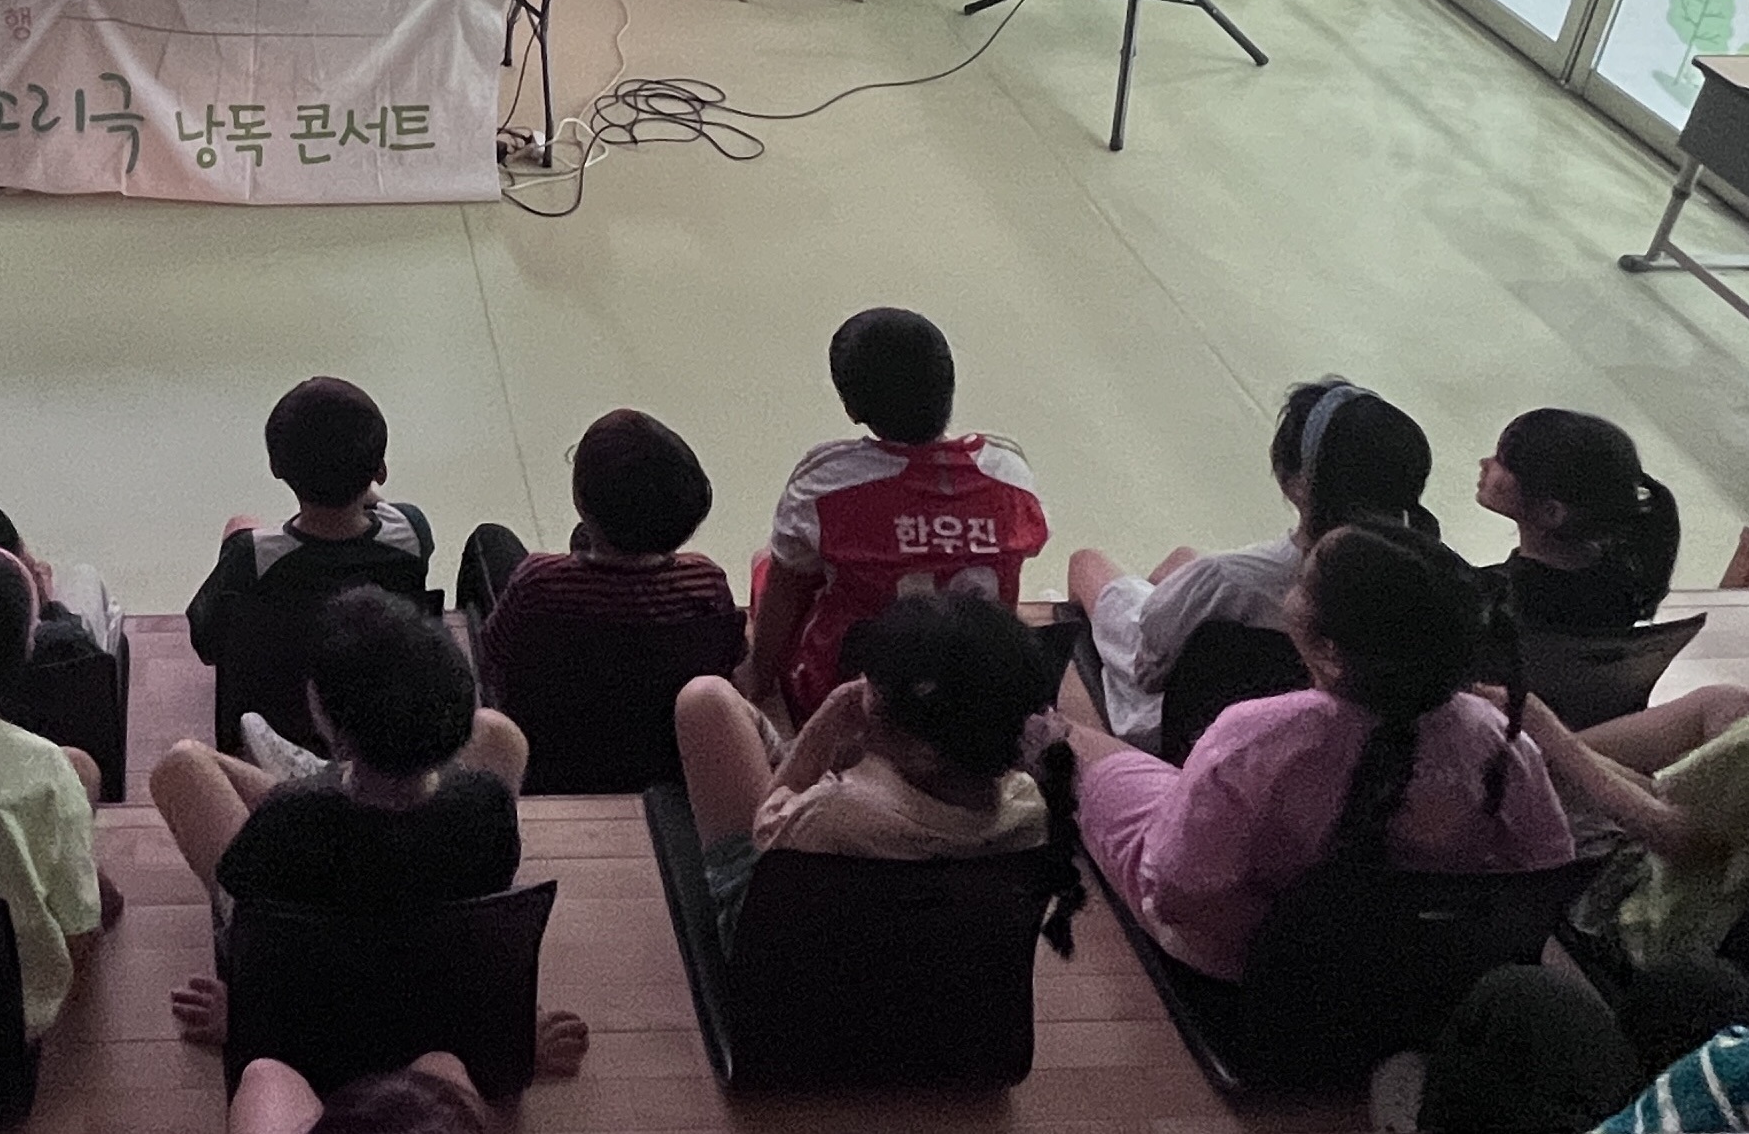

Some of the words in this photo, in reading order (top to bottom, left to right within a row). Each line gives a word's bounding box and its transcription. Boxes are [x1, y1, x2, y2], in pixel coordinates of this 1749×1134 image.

[174, 103, 273, 169] 낭독
[289, 103, 436, 166] 콘서트
[894, 515, 1000, 554] 한우진
